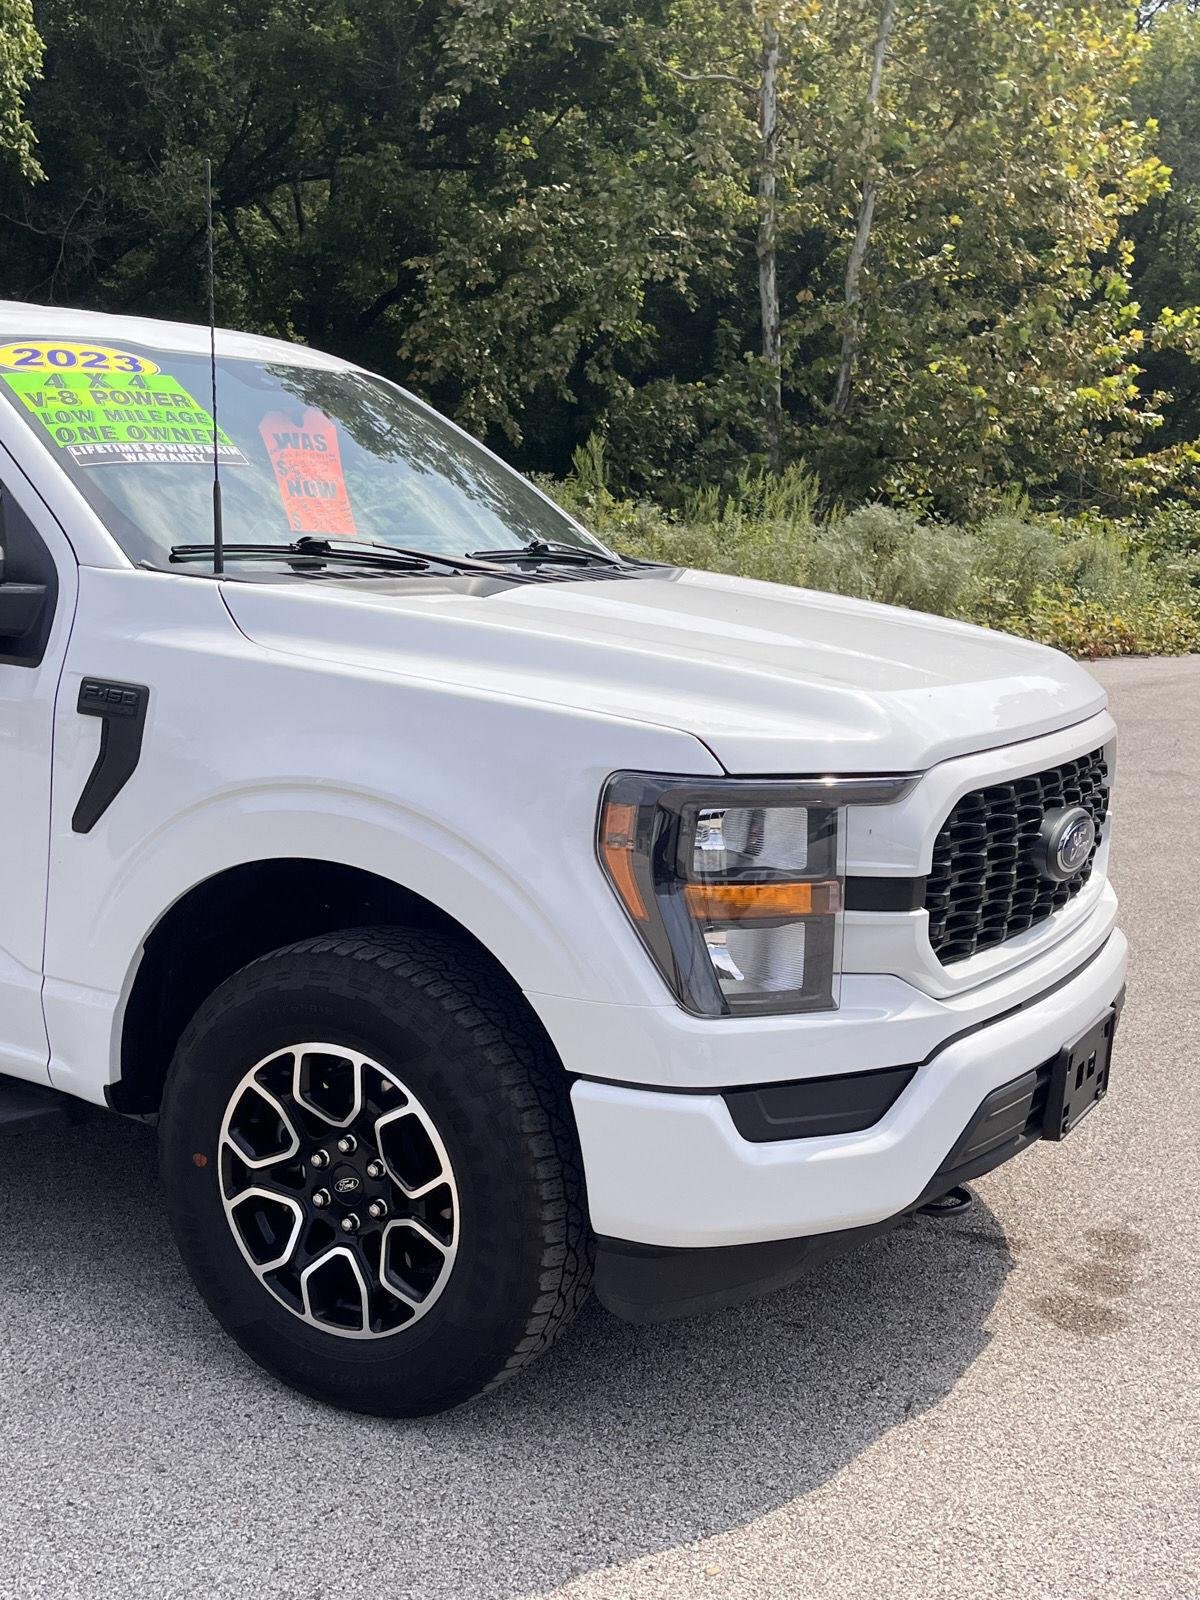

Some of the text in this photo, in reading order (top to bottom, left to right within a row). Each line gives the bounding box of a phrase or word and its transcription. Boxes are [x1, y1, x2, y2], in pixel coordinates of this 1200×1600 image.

[12, 347, 143, 373] 2023
[43, 373, 149, 389] 4 X 4
[24, 390, 192, 410] V-8 POWER
[41, 409, 213, 426] LOW MILEAGE
[55, 425, 230, 445] ONE OWNER
[272, 432, 328, 452] WAS
[70, 443, 142, 455] LIFETIME
[122, 452, 206, 463] WARRANTY
[286, 480, 337, 499] NOW
